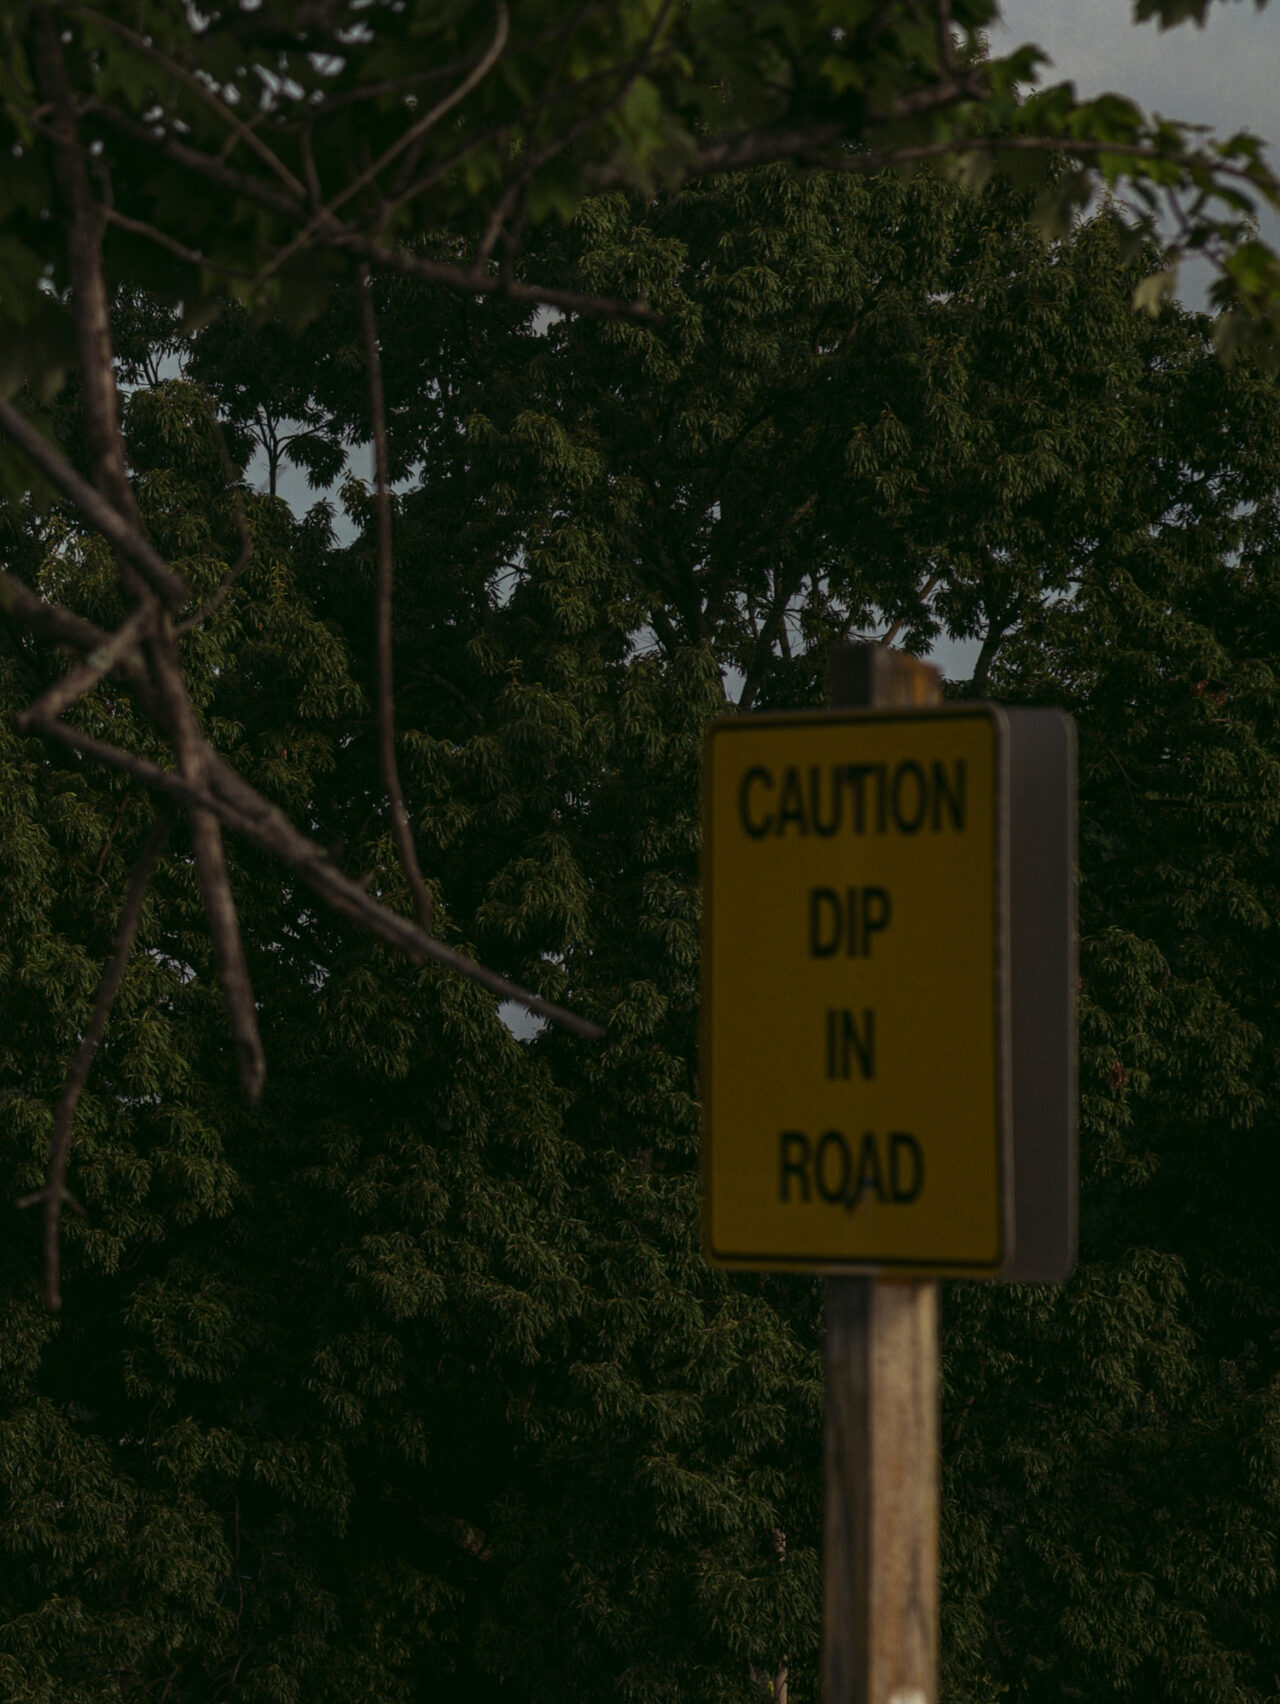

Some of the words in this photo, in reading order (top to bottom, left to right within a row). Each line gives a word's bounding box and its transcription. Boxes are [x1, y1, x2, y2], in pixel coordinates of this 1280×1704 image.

[738, 758, 967, 840] CAUTION
[809, 885, 892, 959] DIP
[826, 1009, 875, 1081] IN
[778, 1129, 925, 1205] ROAD
